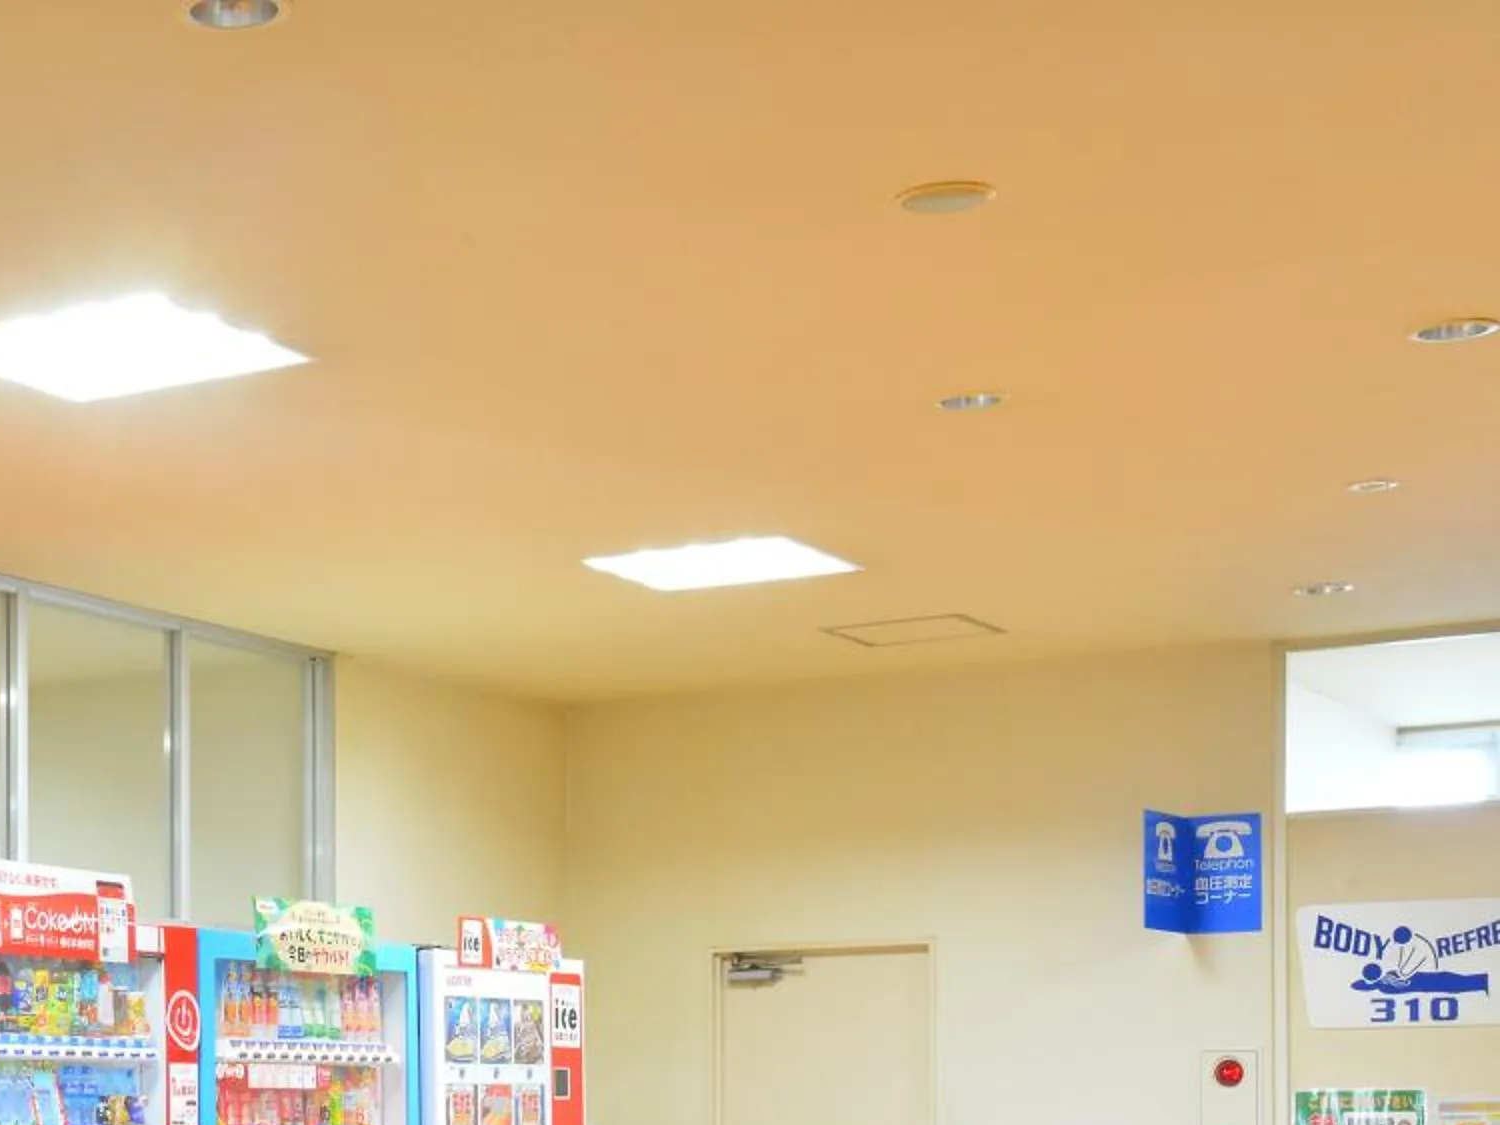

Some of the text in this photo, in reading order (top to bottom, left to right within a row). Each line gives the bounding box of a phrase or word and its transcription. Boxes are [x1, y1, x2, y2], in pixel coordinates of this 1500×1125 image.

[1195, 890, 1252, 905] コーナー
[24, 905, 68, 932] Coke
[463, 936, 480, 952] ice
[1314, 914, 1390, 960] BODY
[555, 999, 578, 1030] ice
[1370, 996, 1459, 1023] 310
